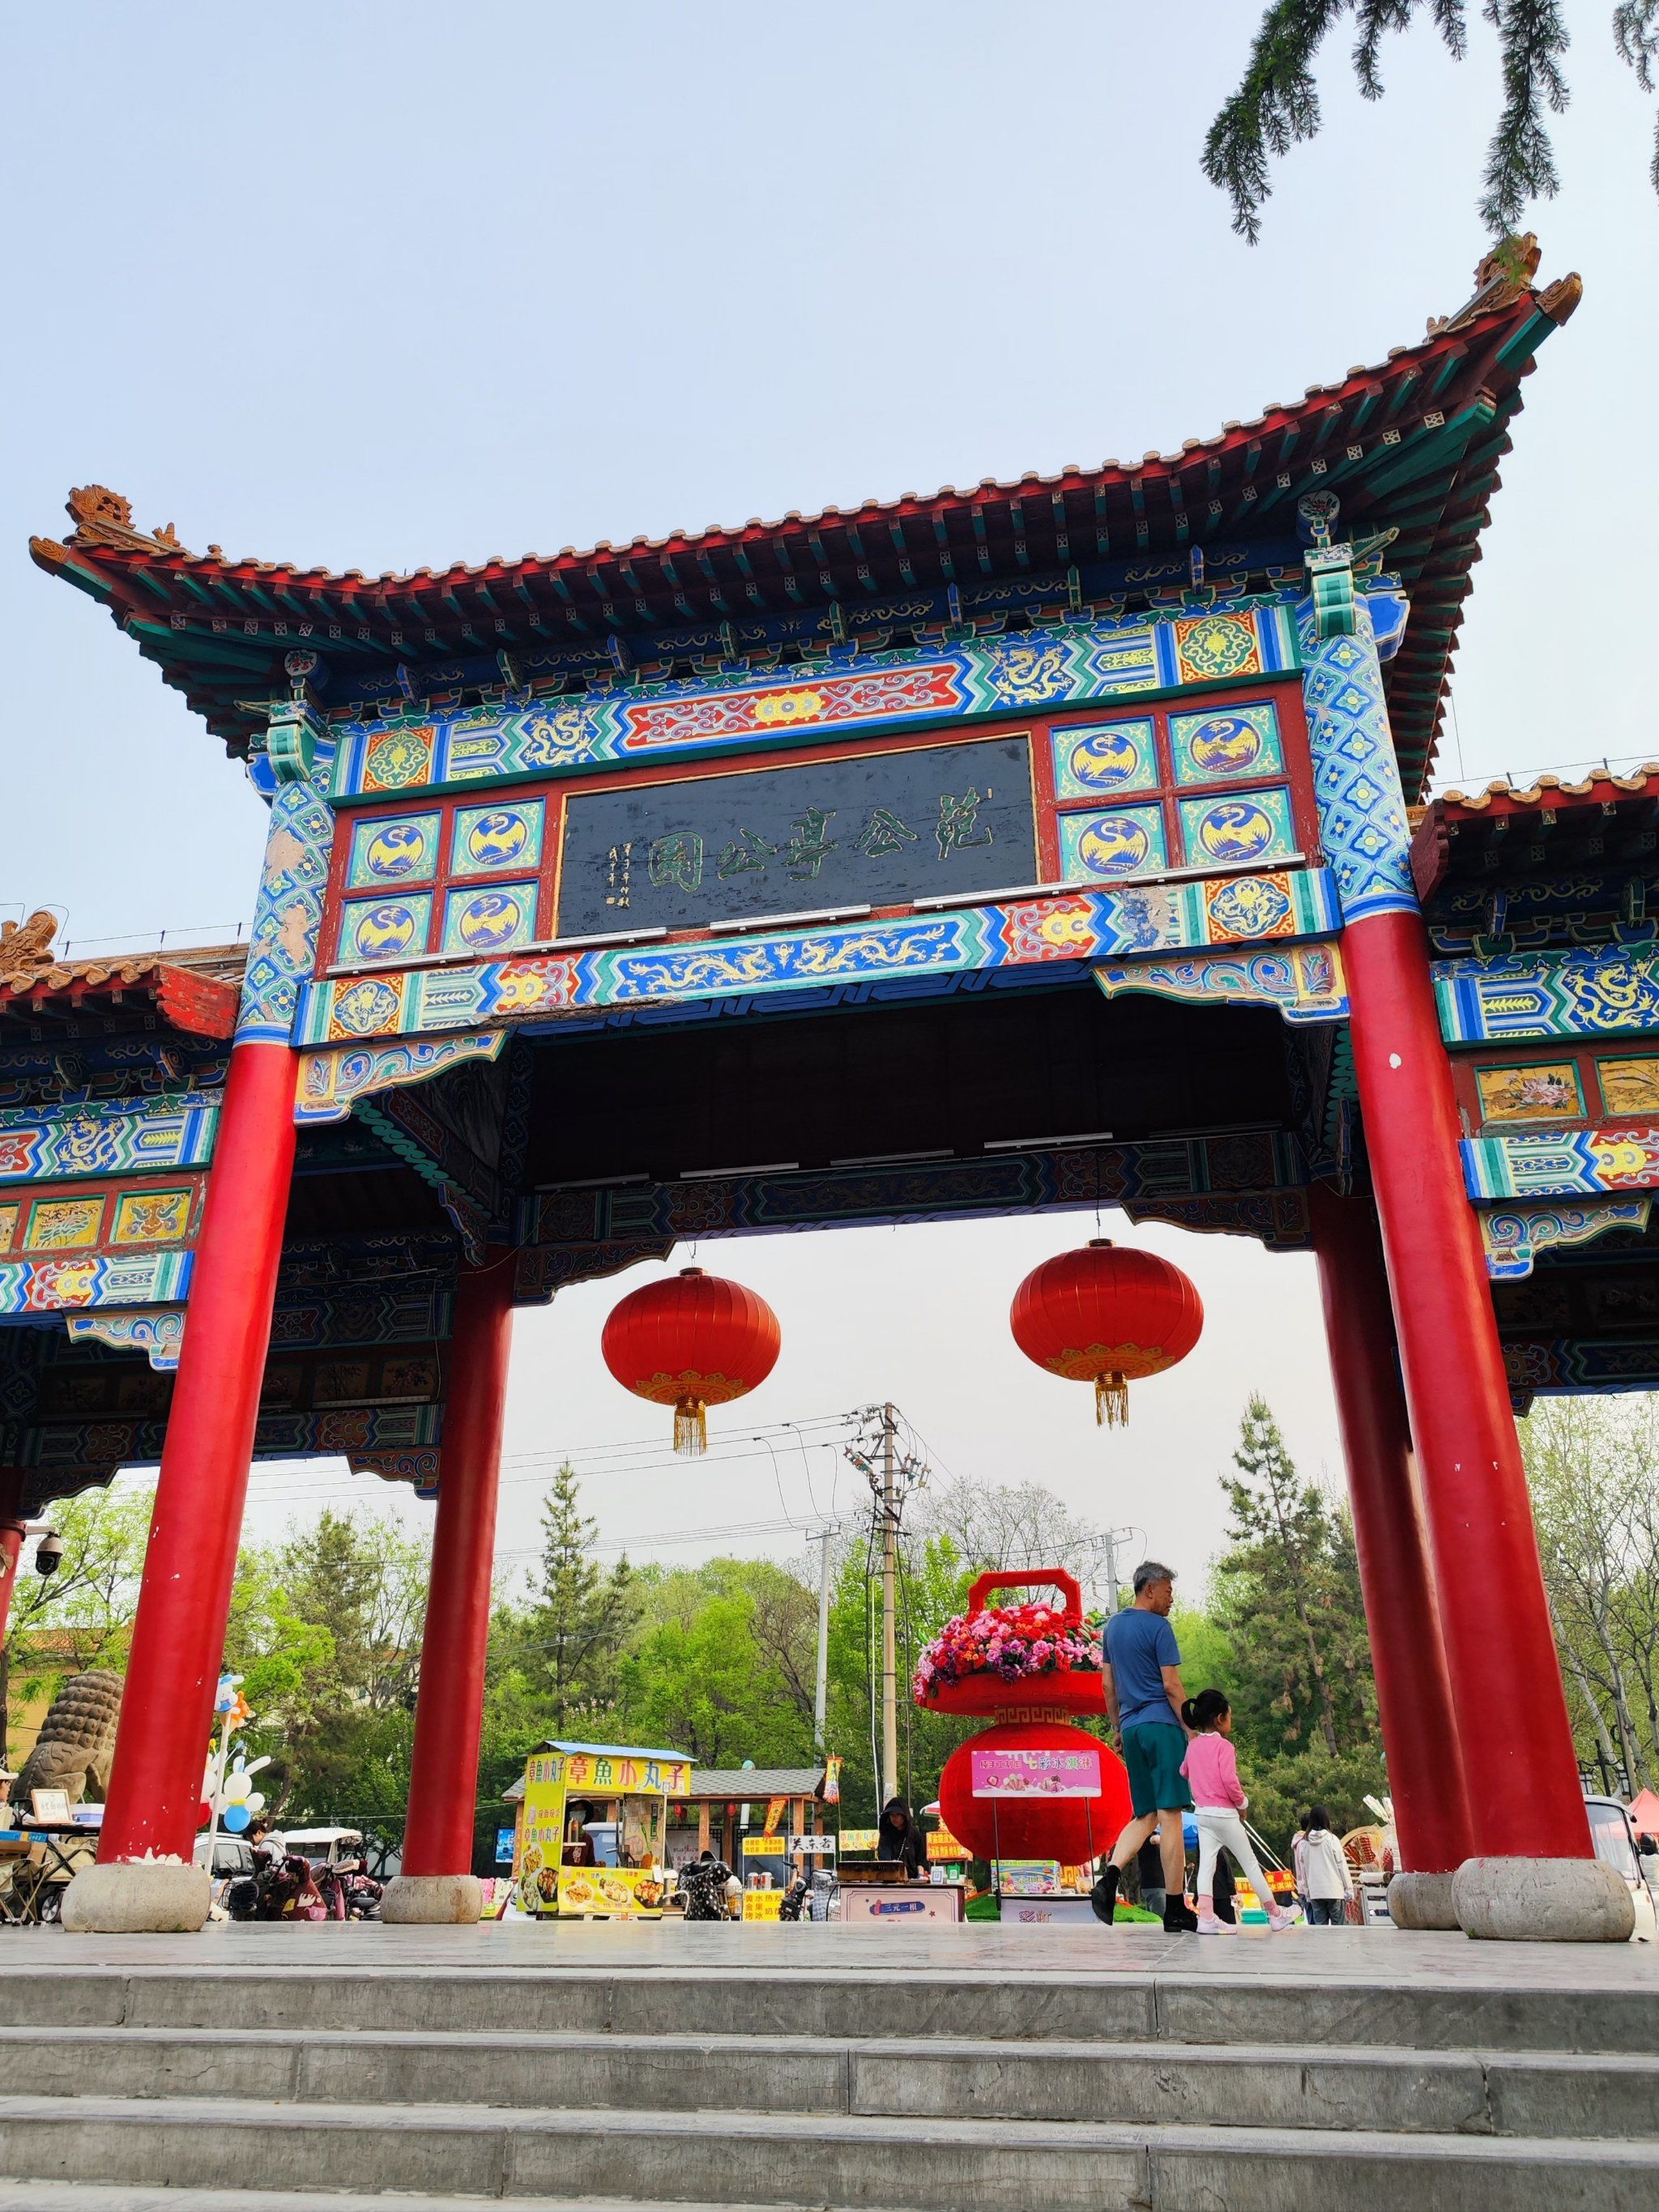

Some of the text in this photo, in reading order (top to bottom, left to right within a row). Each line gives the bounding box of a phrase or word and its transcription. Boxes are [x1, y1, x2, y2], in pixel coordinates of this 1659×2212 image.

[1027, 1756, 1093, 1771] 七彩冰淇淋
[792, 1837, 834, 1852] 关东煮
[884, 1903, 918, 1912] 三元一根
